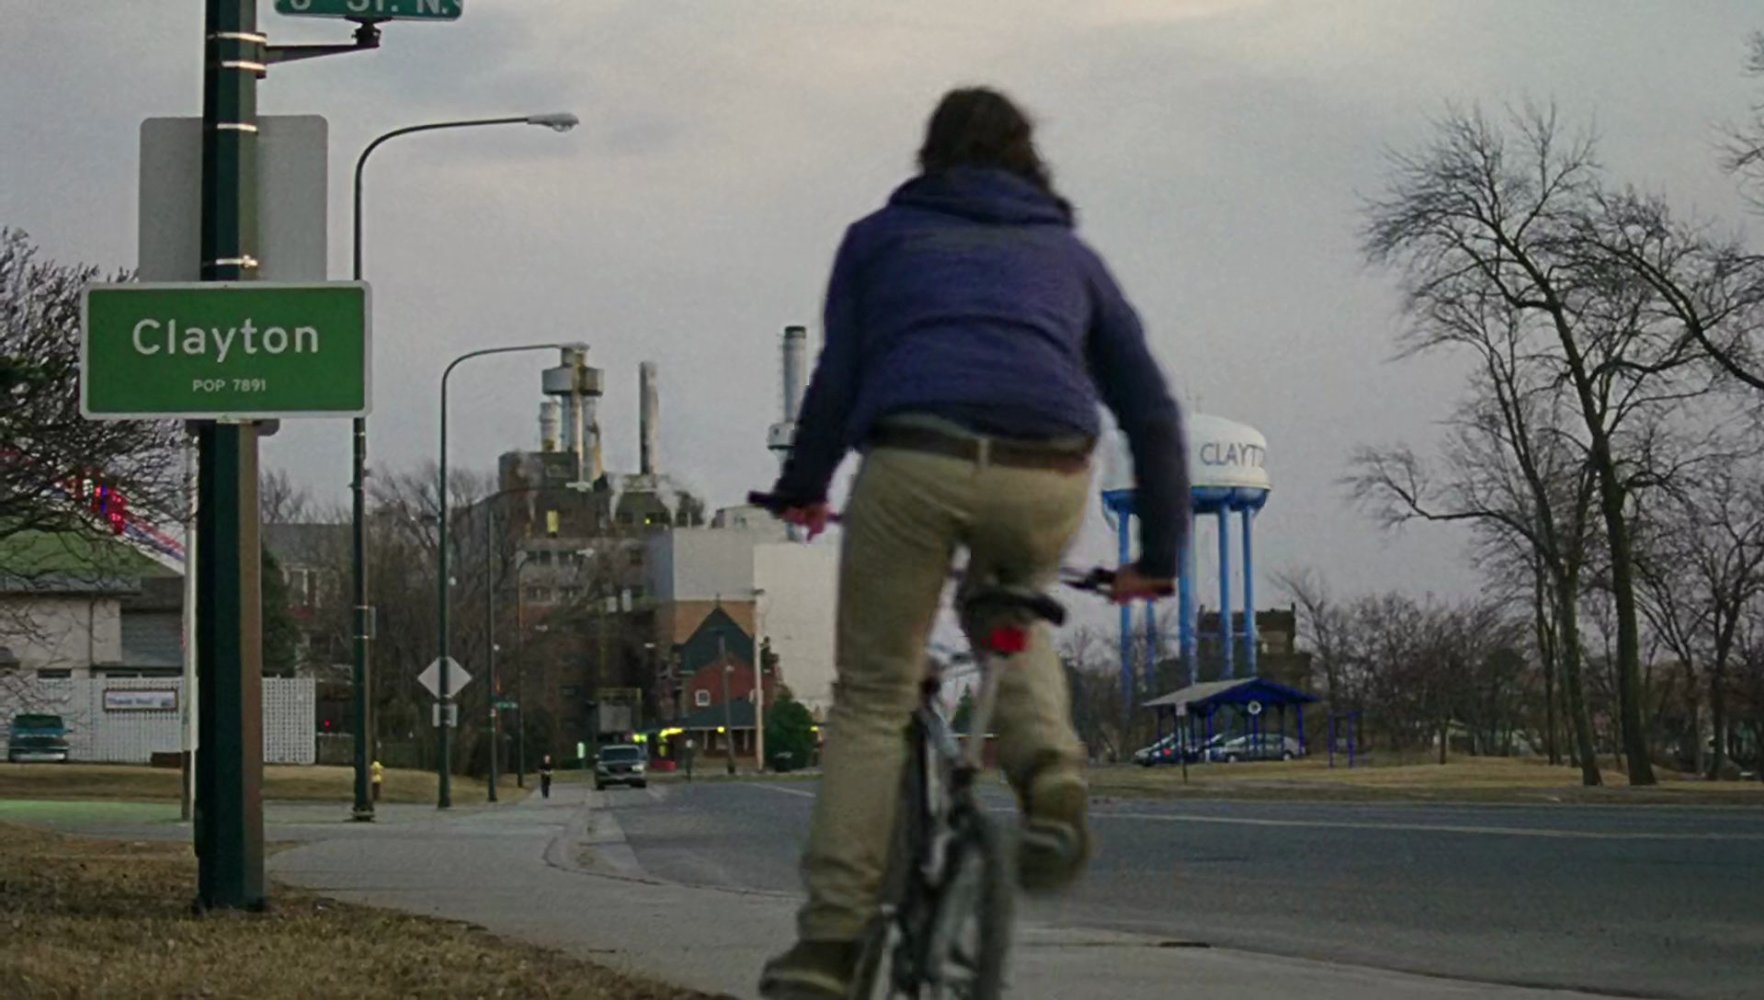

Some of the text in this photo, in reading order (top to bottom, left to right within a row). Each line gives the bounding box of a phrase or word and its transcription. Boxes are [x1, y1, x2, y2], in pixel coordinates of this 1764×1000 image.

[132, 318, 319, 363] Clayton
[192, 378, 267, 392] POP 7891
